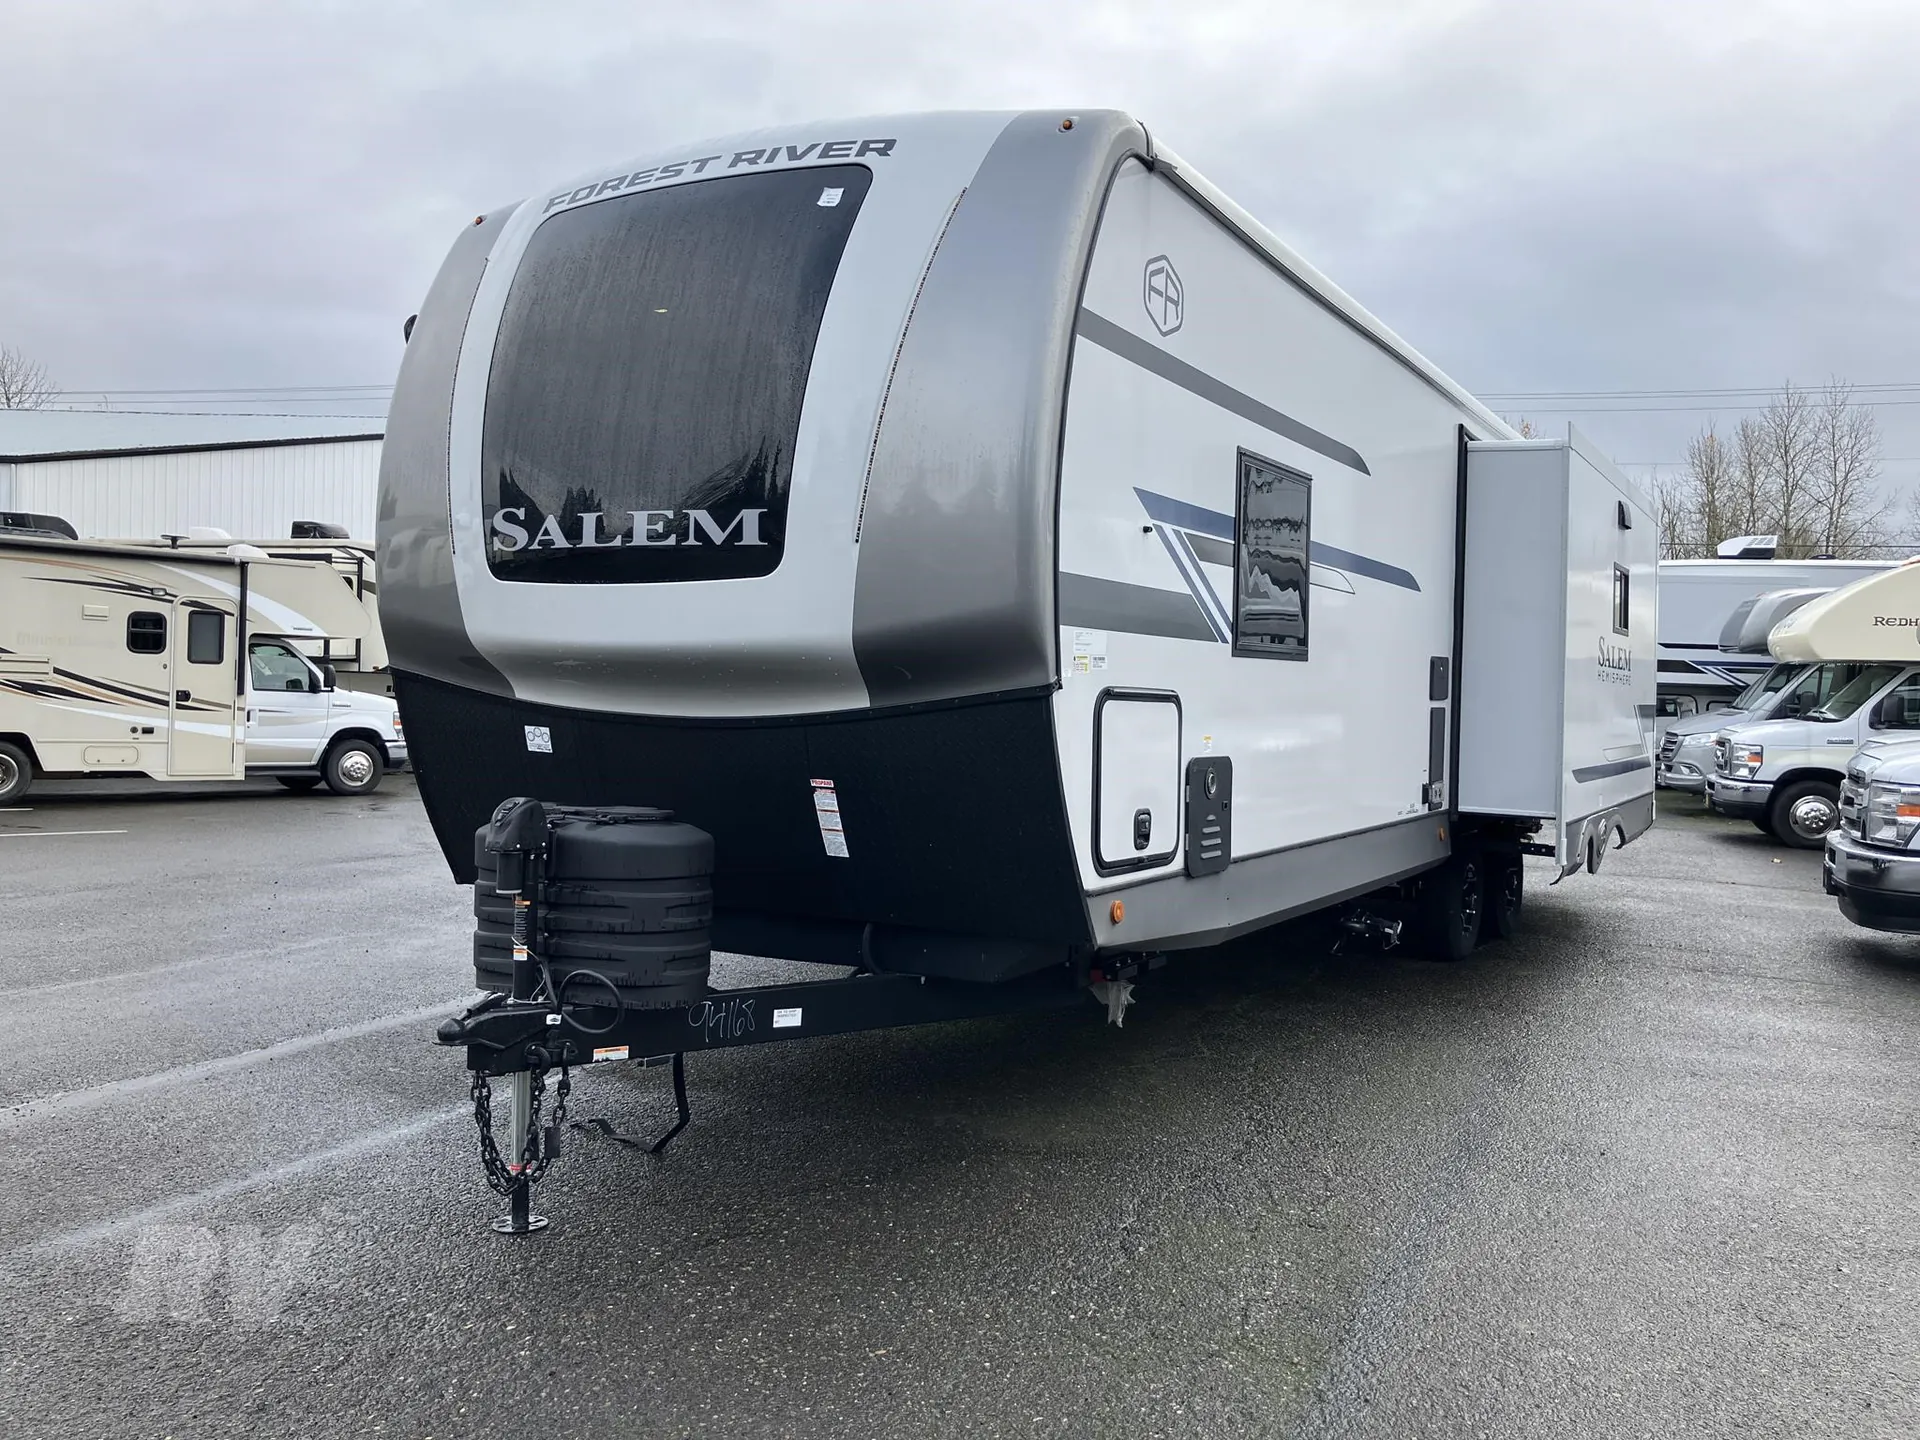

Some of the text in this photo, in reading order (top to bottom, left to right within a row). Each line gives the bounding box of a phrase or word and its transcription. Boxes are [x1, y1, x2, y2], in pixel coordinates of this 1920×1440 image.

[542, 138, 897, 214] FOREST RIVER
[492, 506, 769, 552] SALEM
[1597, 635, 1632, 672] SALEM
[688, 998, 756, 1043] 94168
